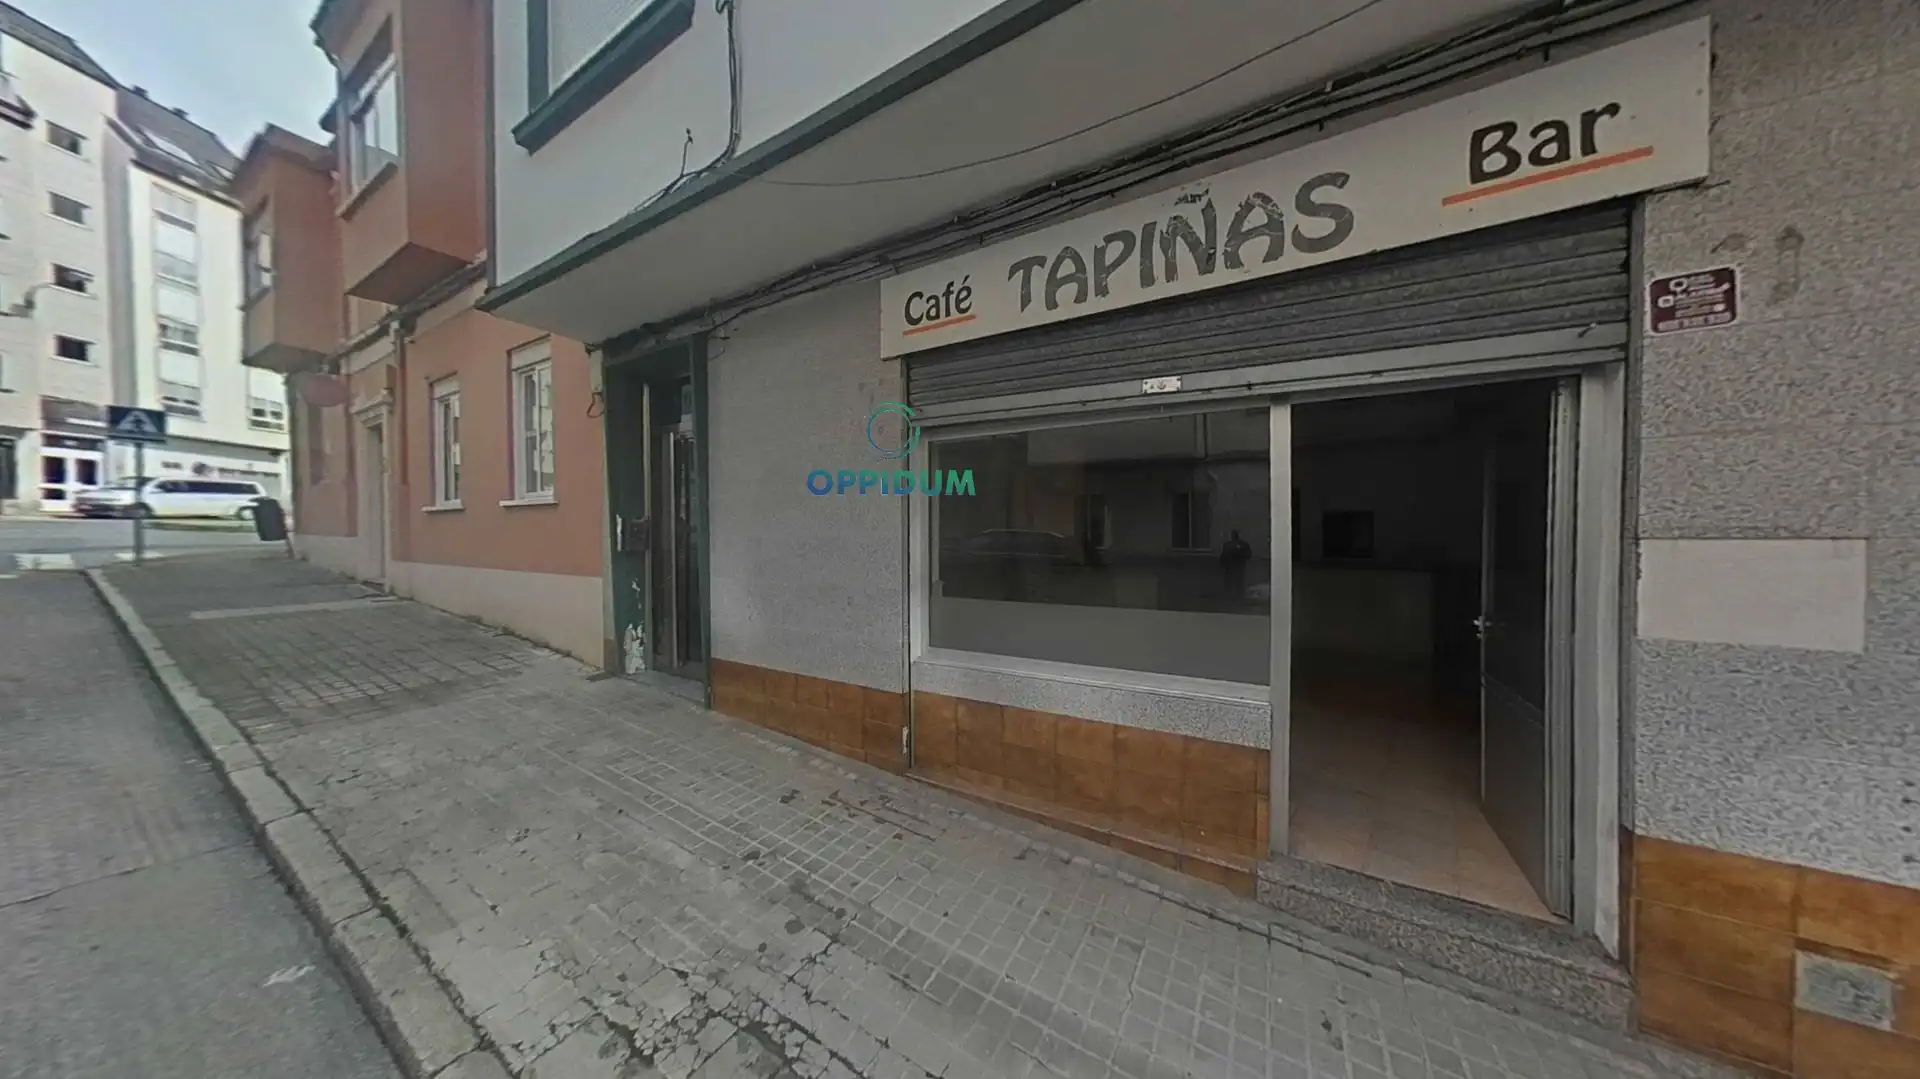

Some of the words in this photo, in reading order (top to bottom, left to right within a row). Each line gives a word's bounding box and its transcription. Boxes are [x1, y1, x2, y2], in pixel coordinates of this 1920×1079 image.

[904, 274, 973, 327] Café
[1008, 171, 1355, 313] TAPIÑAS
[1469, 102, 1621, 185] Bar
